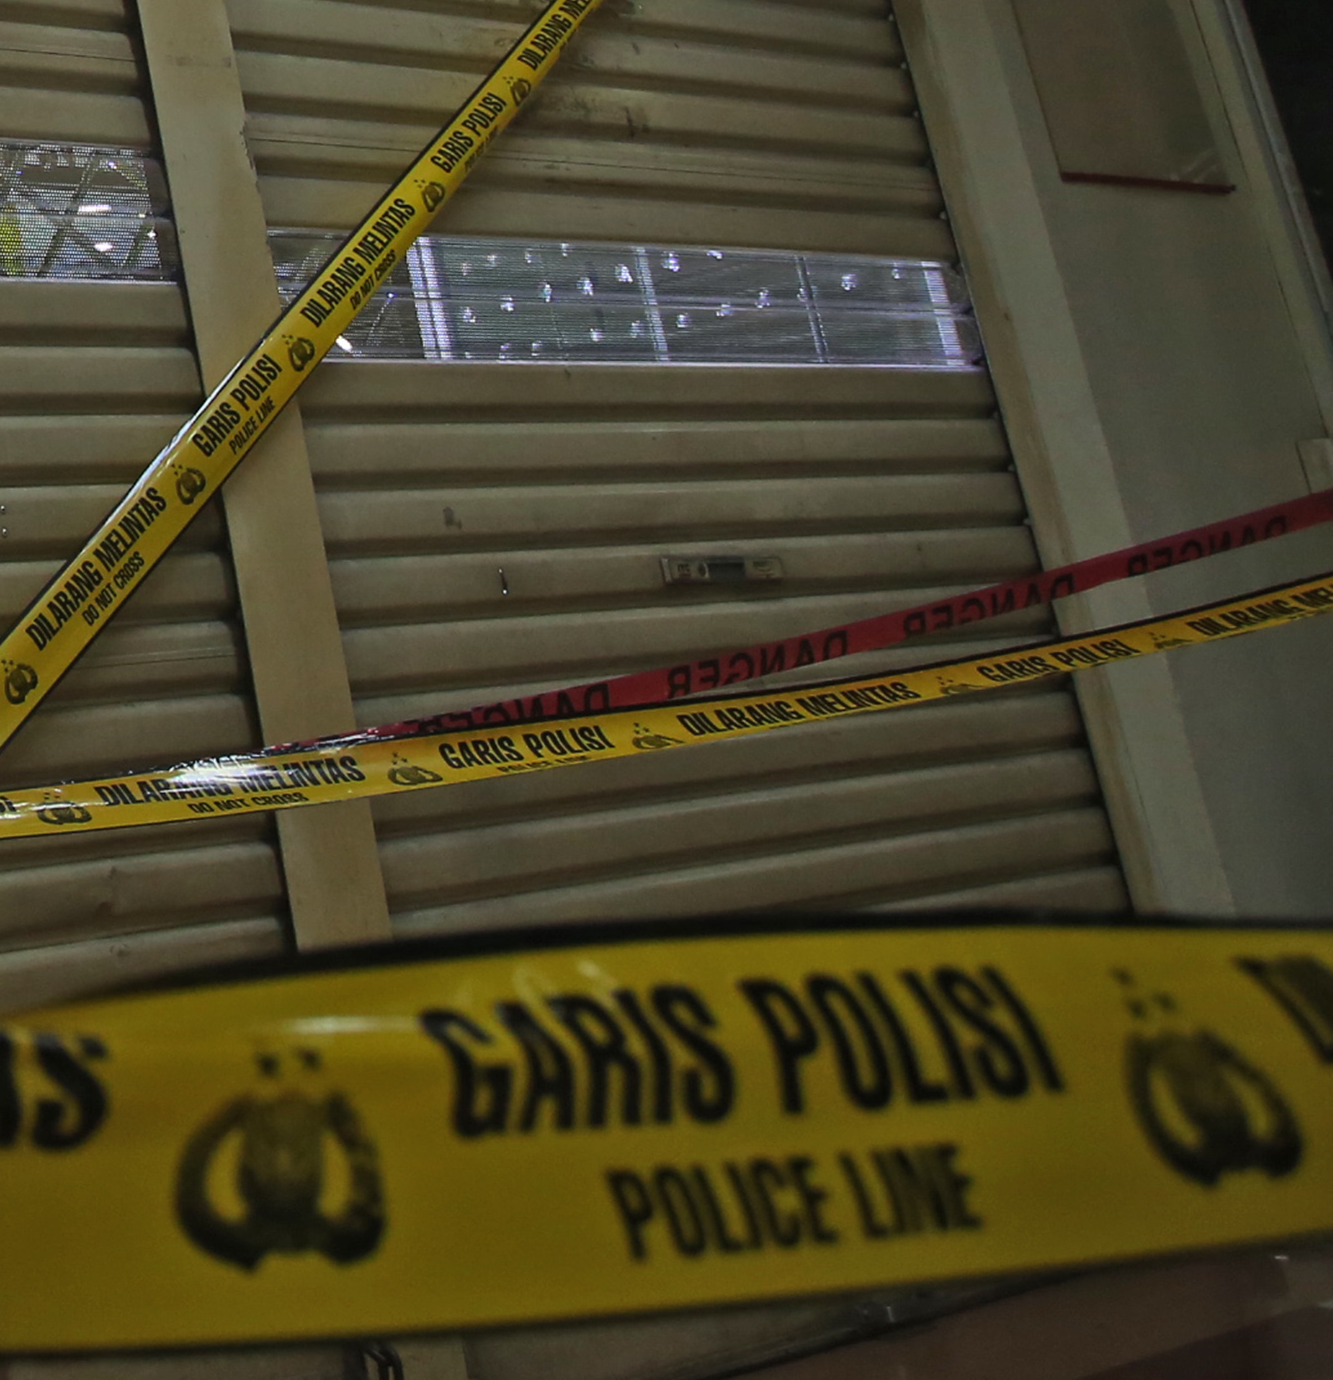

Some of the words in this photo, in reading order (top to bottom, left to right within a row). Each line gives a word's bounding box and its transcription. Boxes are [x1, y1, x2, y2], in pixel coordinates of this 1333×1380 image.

[517, 13, 573, 71] DILARANG
[430, 130, 475, 174] GARIS
[461, 92, 508, 138] POLISI
[299, 256, 367, 329] DILARANG
[352, 197, 416, 266] MELINTAS
[349, 290, 362, 311] DO
[360, 274, 376, 300] NOT
[191, 401, 242, 458] GARIS
[229, 353, 284, 412] POLISI
[228, 418, 259, 456] POLICE
[258, 395, 277, 424] LINE
[24, 559, 102, 652] DILARANG
[94, 486, 168, 570] MELINTAS
[81, 608, 100, 627] DO
[97, 587, 117, 616] NOT
[114, 551, 146, 593] CROSS
[1184, 599, 1300, 637] DILARANG
[976, 656, 1050, 684] GARIS
[1050, 638, 1142, 667] POLISI
[676, 700, 802, 737] DILARANG
[799, 681, 922, 722] MELINTAS
[437, 735, 525, 770] GARIS
[522, 724, 616, 759] POLISI
[93, 775, 231, 807] DILARANG
[239, 754, 367, 794] MELINTAS
[186, 801, 216, 815] DO
[216, 797, 250, 813] NOT
[253, 791, 310, 808] CROSS
[418, 982, 740, 1140] GARIS
[738, 965, 1067, 1118] POLISI
[606, 1154, 841, 1265] POLICE
[835, 1144, 985, 1235] LINE
